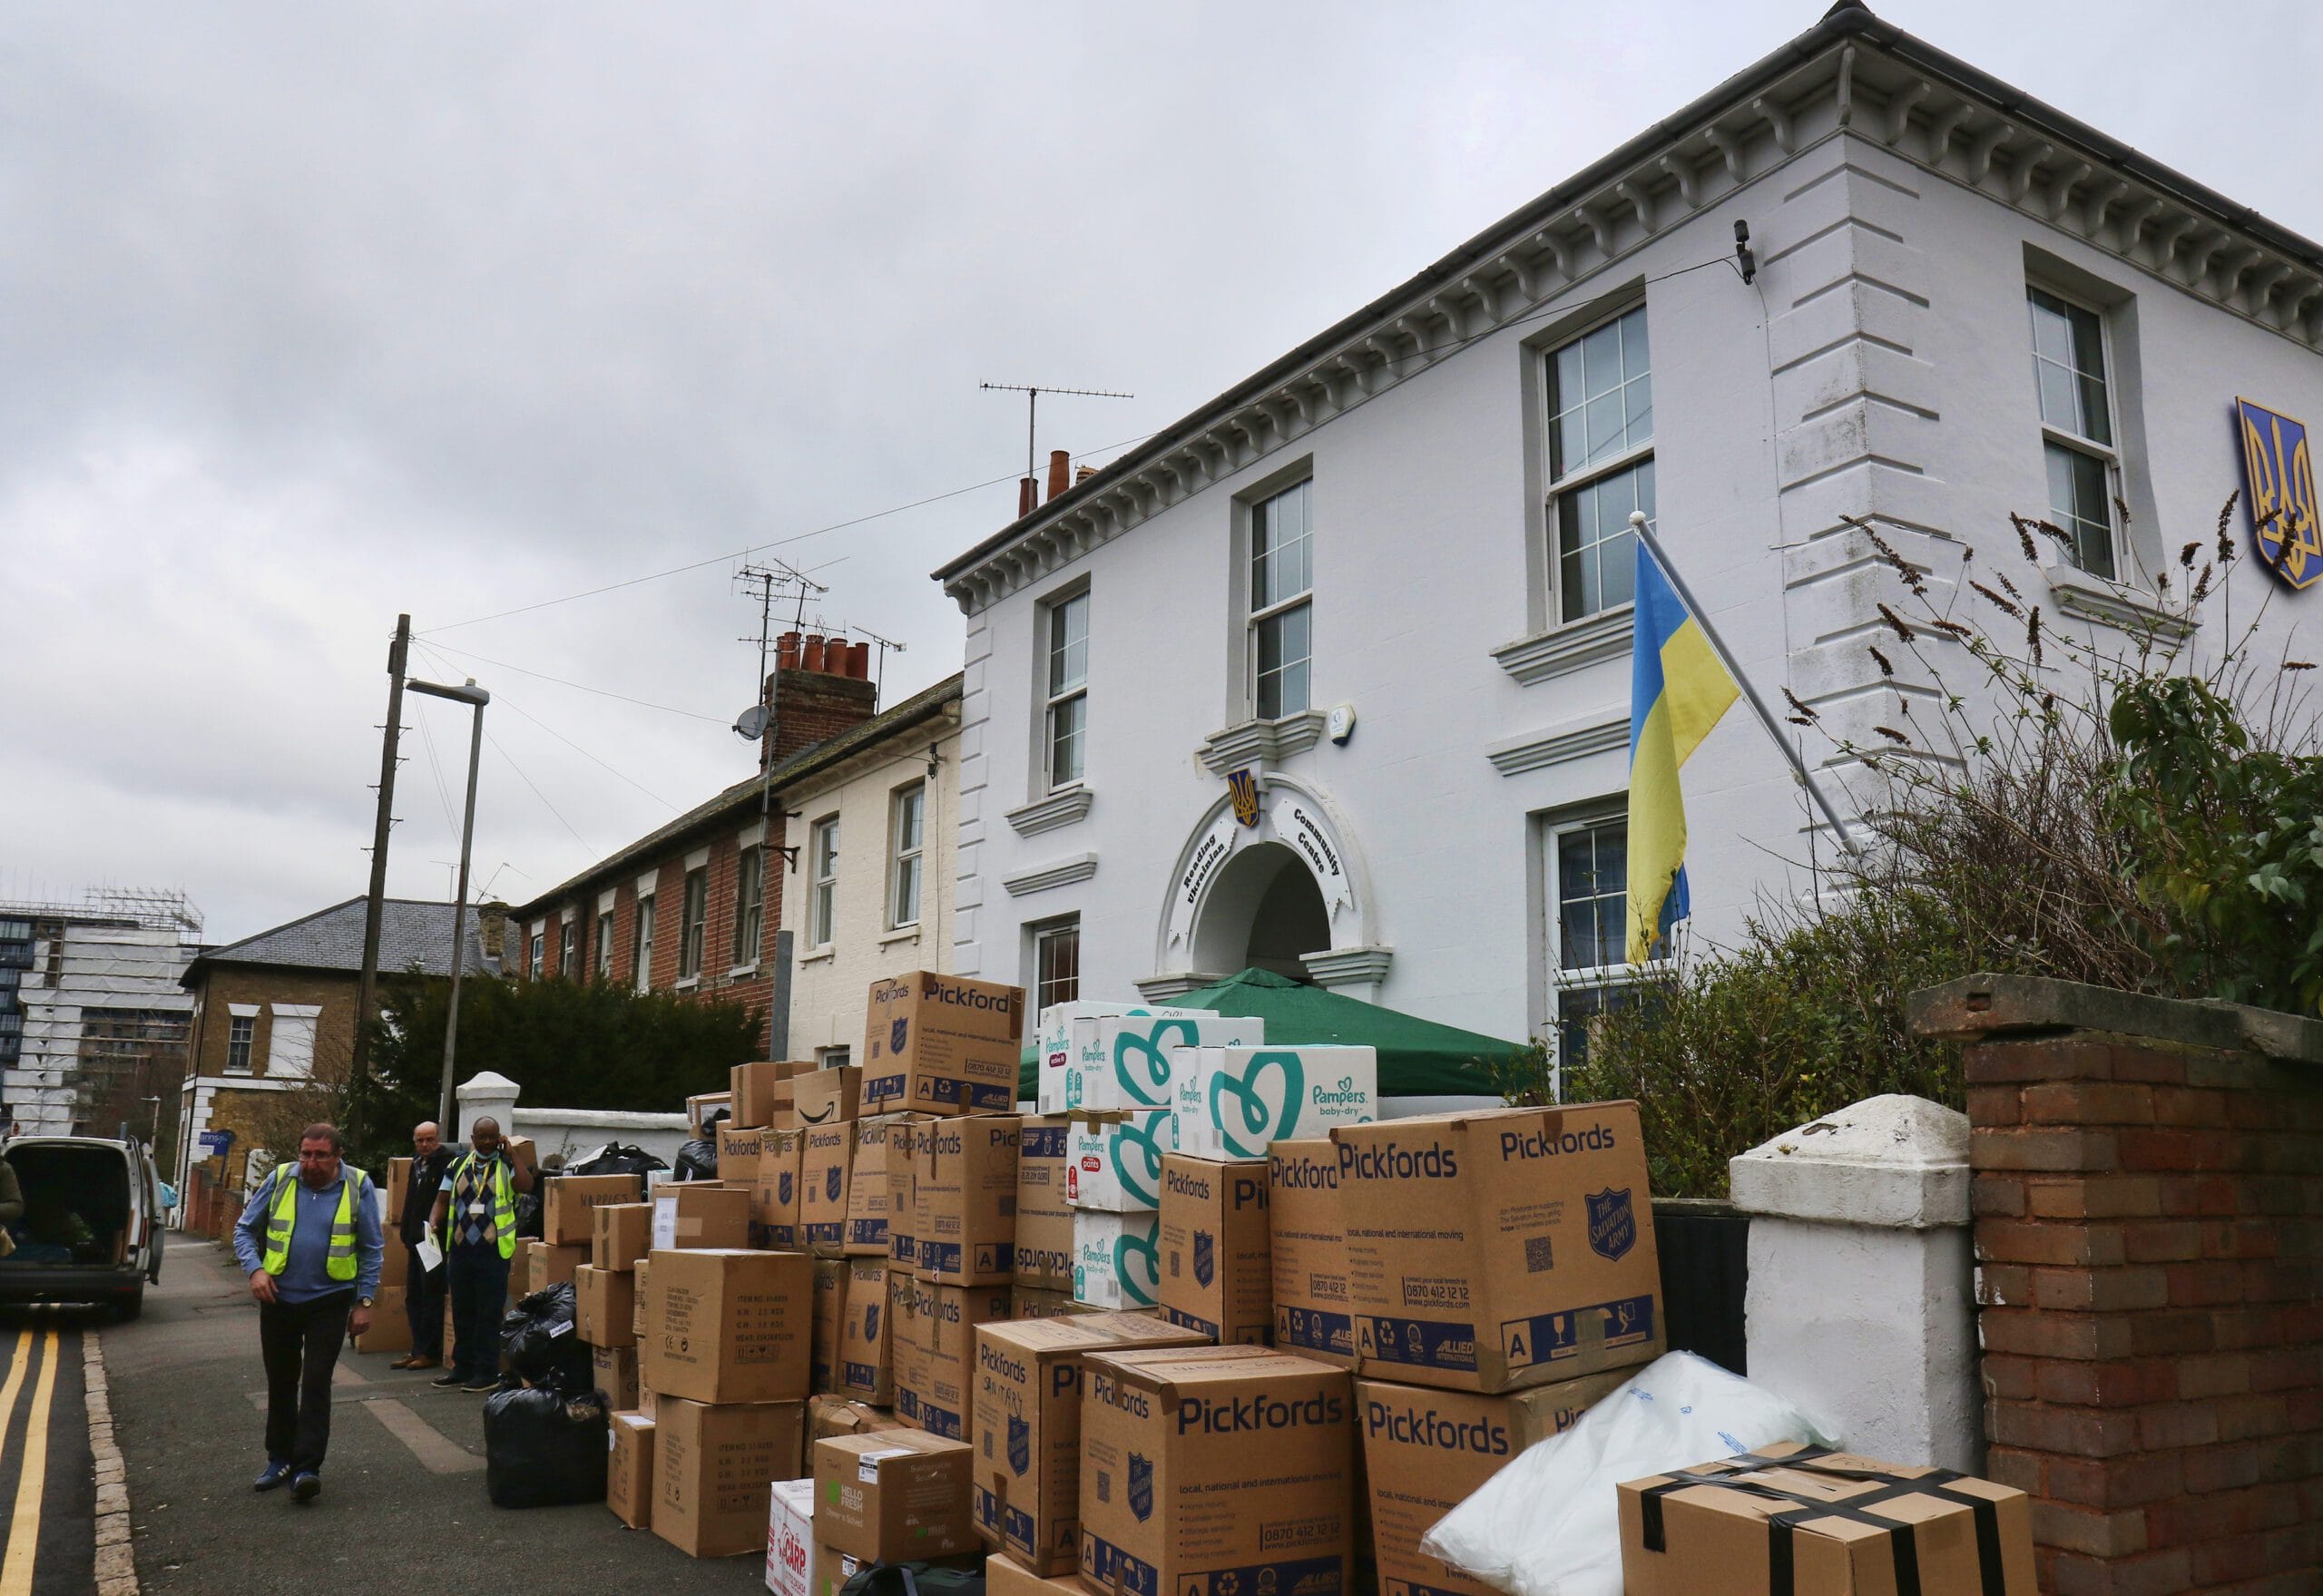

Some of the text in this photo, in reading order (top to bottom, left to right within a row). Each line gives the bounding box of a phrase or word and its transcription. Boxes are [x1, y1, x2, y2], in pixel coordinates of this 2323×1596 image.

[1294, 809, 1339, 876] Community
[1183, 835, 1216, 888] Reading
[1298, 833, 1324, 873] Centre
[1187, 844, 1225, 904] Ukrainian
[924, 982, 1010, 1013] Pickford
[1045, 1036, 1069, 1053] Pampers
[1083, 1045, 1105, 1062] Pampers
[920, 1082, 929, 1094] A
[1180, 1082, 1201, 1103] Pampers
[1314, 1085, 1365, 1106] Pampers
[1320, 1107, 1358, 1116] baby-dry
[809, 1133, 840, 1149] Pickfords
[1079, 1137, 1103, 1153] Pampers
[1083, 1160, 1099, 1170] pants
[1338, 1142, 1457, 1180] Pickfords
[1272, 1156, 1338, 1189] Pickford
[1168, 1169, 1209, 1199] Pickfords
[1597, 1198, 1612, 1216] THE
[1592, 1204, 1630, 1244] SALVATION
[1362, 1229, 1384, 1239] national
[1386, 1229, 1396, 1239] and
[1397, 1229, 1437, 1239] international
[1438, 1231, 1463, 1241] moving
[1608, 1226, 1630, 1252] ARMY
[979, 1252, 992, 1266] A
[1083, 1244, 1110, 1265] Pampers
[1313, 1280, 1346, 1294] 0870 412 12
[1407, 1285, 1468, 1299] 0870 412 12 12
[1407, 1299, 1470, 1308] www.pickfords.com
[1280, 1316, 1288, 1334] A
[1330, 1328, 1351, 1341] ALLIE
[1361, 1327, 1372, 1349] A
[1437, 1340, 1474, 1353] ALLIED
[1509, 1334, 1526, 1357] A
[982, 1343, 1026, 1384] Pickfords
[1094, 1374, 1149, 1419] Pickords
[1179, 1391, 1344, 1435] Pickfords
[1368, 1401, 1508, 1455] Pickfords
[841, 1484, 863, 1501] HELLO
[1180, 1484, 1203, 1494] local,
[1205, 1481, 1240, 1492] national
[1241, 1479, 1258, 1489] and
[1260, 1474, 1310, 1488] international
[841, 1498, 862, 1512] FRESH
[975, 1495, 982, 1514] A
[1377, 1488, 1394, 1501] local,
[1395, 1491, 1422, 1504] national
[1423, 1497, 1436, 1507] and
[1060, 1529, 1073, 1546] A
[1264, 1523, 1340, 1542] 0870 412 12 12
[786, 1537, 806, 1575] CARP
[1084, 1544, 1093, 1565] A
